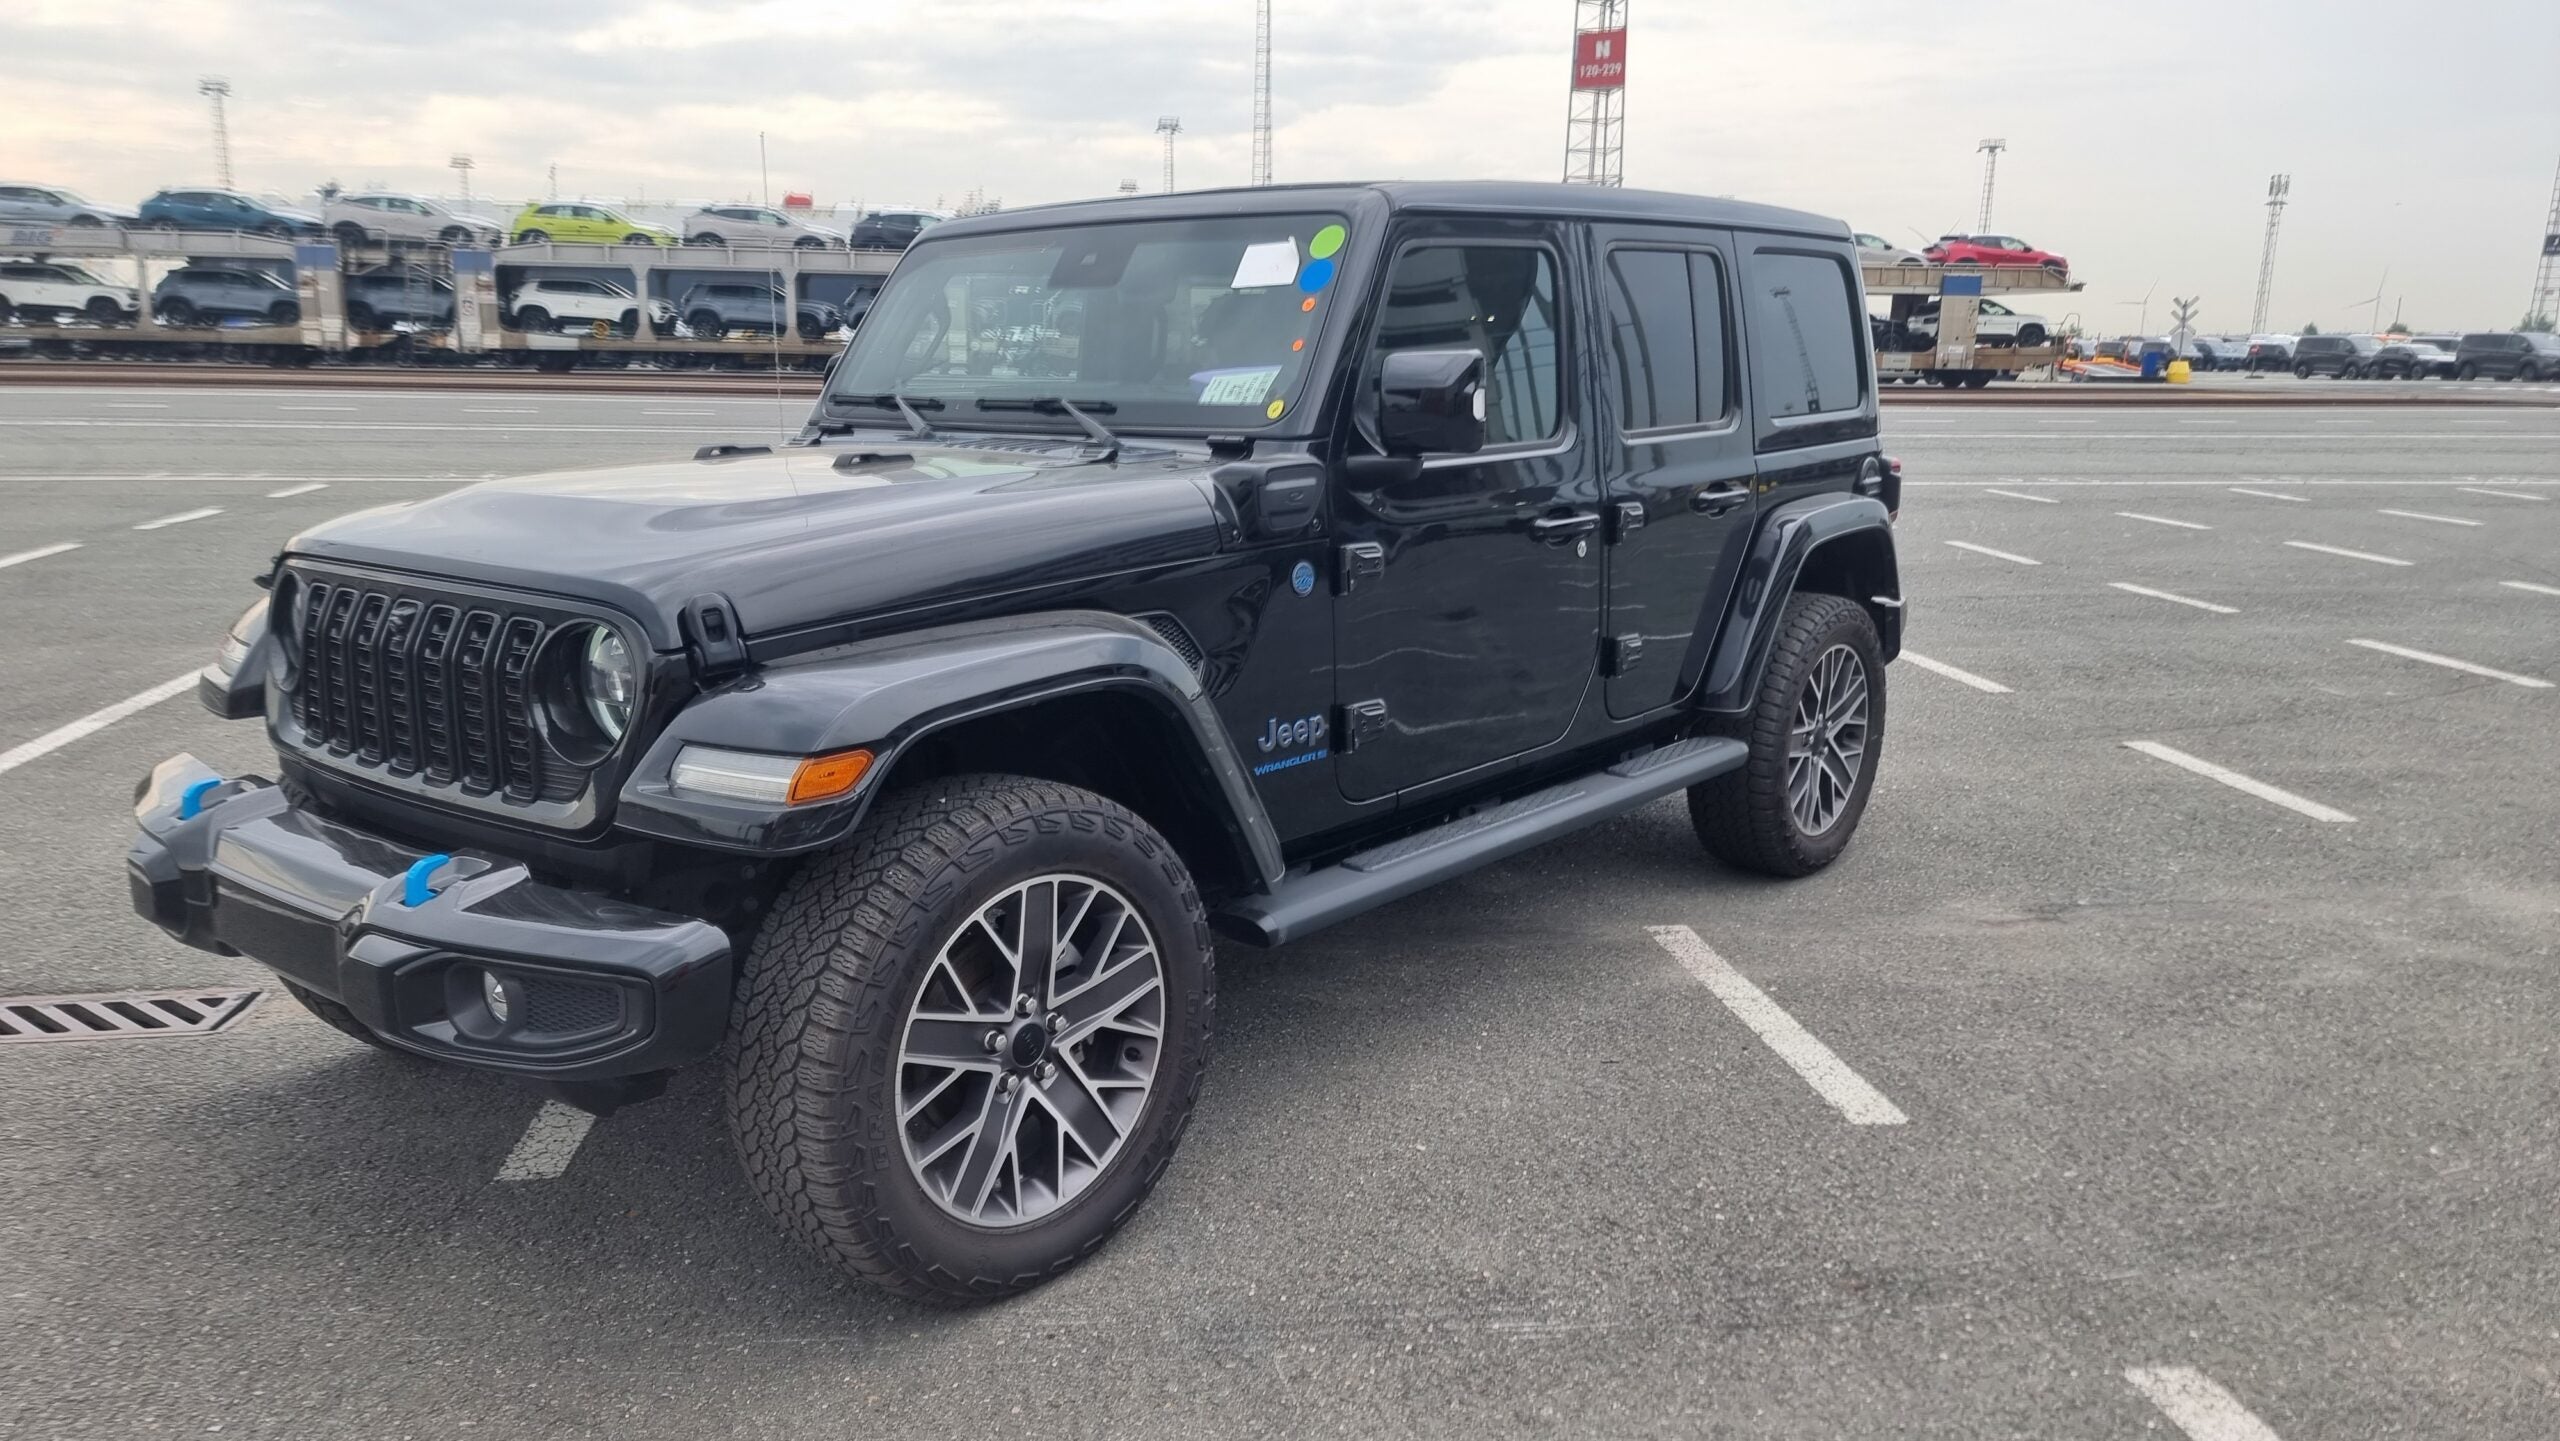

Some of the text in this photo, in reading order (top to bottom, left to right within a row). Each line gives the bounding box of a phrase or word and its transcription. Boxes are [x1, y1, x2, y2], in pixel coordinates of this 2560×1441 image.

[1595, 39, 1611, 60] N
[1257, 714, 1326, 753] Jeep
[1254, 751, 1316, 776] WRANGLER
